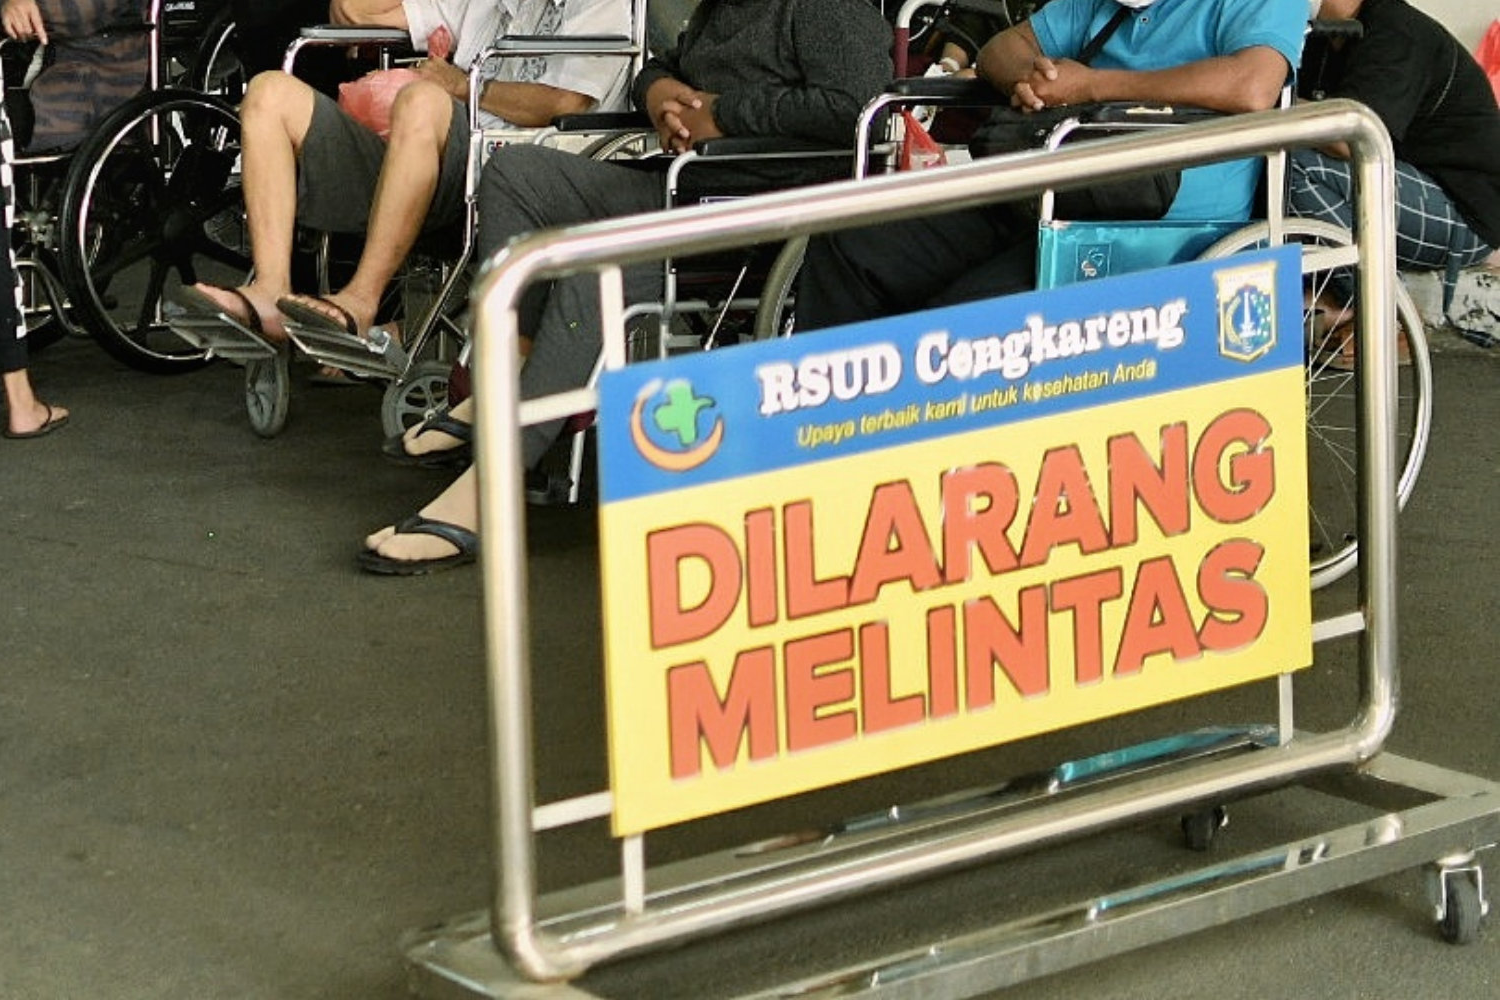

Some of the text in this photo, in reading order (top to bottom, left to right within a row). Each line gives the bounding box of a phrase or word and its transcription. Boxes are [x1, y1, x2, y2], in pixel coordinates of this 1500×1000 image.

[757, 299, 1188, 416] RSUD Cengkareng
[797, 357, 1157, 449] Upaya terbaik kami untuk kesehatan Anda
[646, 408, 1276, 652] DILARANG
[666, 537, 1270, 782] MELINTAS
